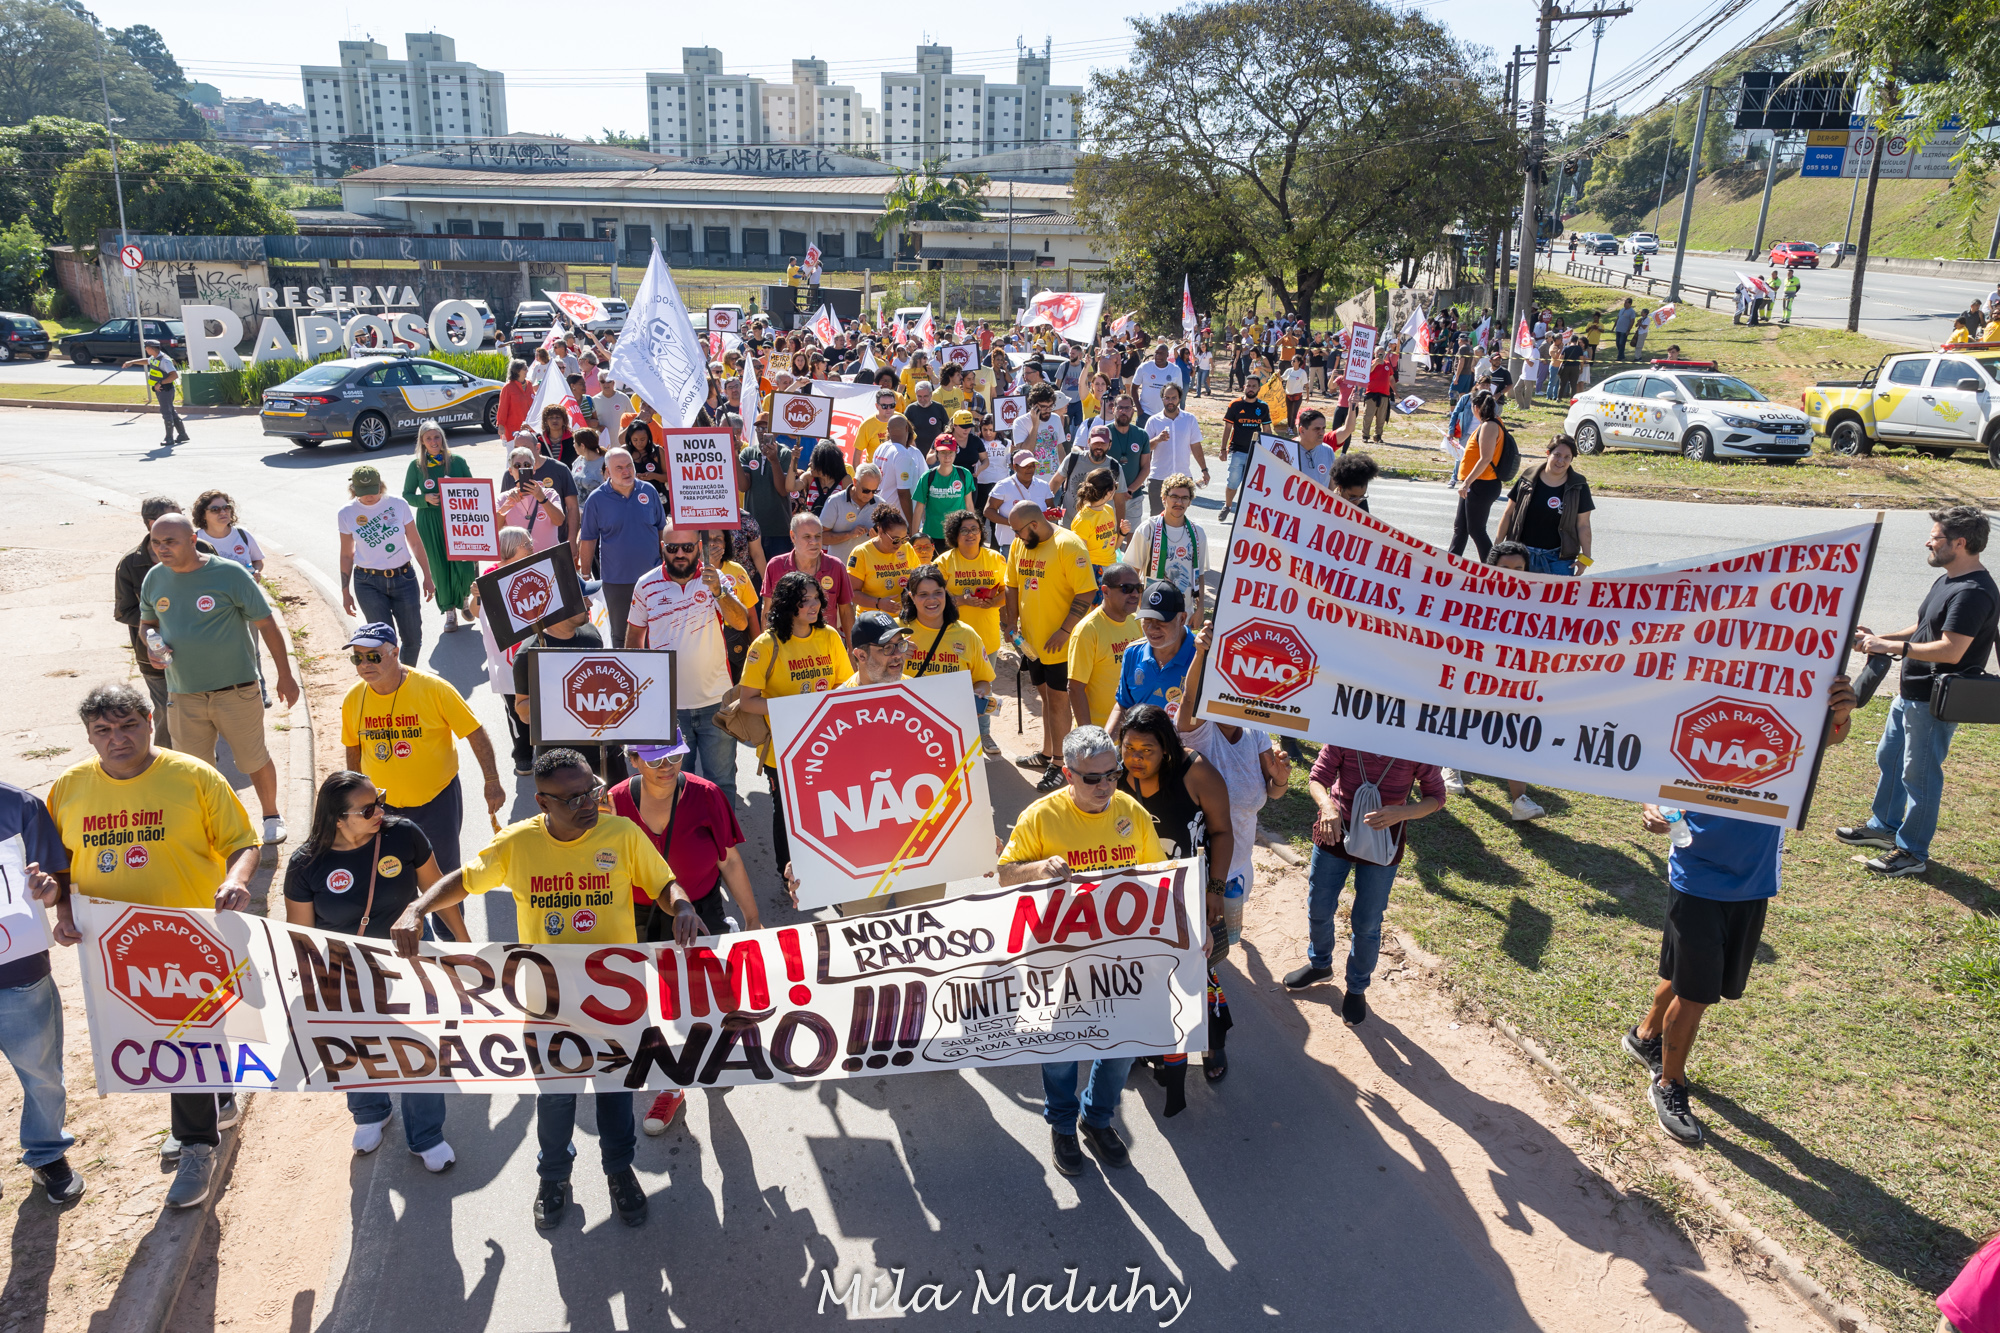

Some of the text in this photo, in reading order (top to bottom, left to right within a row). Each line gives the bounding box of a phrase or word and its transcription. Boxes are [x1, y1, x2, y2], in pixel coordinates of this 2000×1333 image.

[1891, 141, 1903, 150] 80
[257, 286, 420, 308] RESERVA
[181, 299, 484, 371] RAPOSO
[438, 413, 474, 424] MILITAR
[788, 411, 811, 423] NÃO
[1003, 410, 1017, 420] NÃO
[1935, 405, 1960, 418] DER
[1633, 427, 1675, 441] POLÍCIA
[683, 438, 716, 450] NOVA
[676, 451, 727, 464] RAPOSO,
[681, 462, 724, 482] NÃO!
[1247, 463, 1271, 498] A,
[447, 486, 480, 498] METRÔ
[448, 498, 478, 510] SIM!
[450, 512, 490, 522] PEDÁGIO
[360, 522, 382, 539] QUER
[364, 532, 380, 544] SER
[452, 522, 485, 536] NÃO!
[1152, 523, 1163, 571] PALESTINE
[1243, 502, 1844, 617] ESTA AQUI HÁ 10 ANOS DE EXISTÊNCIA COM
[955, 569, 977, 579] Metrô
[955, 577, 981, 587] Pedágio
[516, 591, 546, 615] NÃO
[1232, 539, 1282, 572] 998
[1289, 556, 1405, 615] FAMÍLIAS,
[1415, 595, 1435, 618] E
[1440, 598, 1621, 647] PRECISAMOS
[1629, 621, 1685, 646] SER
[1693, 618, 1838, 660] OUVIDOS
[1231, 577, 1816, 699] PELO GOVERNADOR TARCISIO DE FREITAS
[787, 654, 833, 671] Metrô sim!
[938, 652, 959, 664] sim!
[790, 668, 822, 682] Pedágio
[942, 663, 960, 673] não!
[1231, 655, 1301, 684] NÃO
[1438, 664, 1544, 703] E CDHU.
[576, 687, 629, 712] NÃO
[1244, 709, 1272, 719] anos
[1290, 705, 1301, 714] 10
[365, 713, 419, 729] Metrô sim!
[1332, 683, 1406, 728] NOVA
[1416, 703, 1543, 753] RAPOSO
[1573, 721, 1642, 771] NÃO
[401, 726, 422, 738] não!
[1690, 738, 1779, 771] NÃO
[817, 768, 948, 838] NÃO
[1705, 793, 1740, 805] anos
[1763, 791, 1778, 801] 10
[82, 809, 164, 833] Metrô sim!
[82, 827, 165, 848] Pedágio não!
[128, 855, 147, 864] NÃO
[1067, 844, 1136, 866] Metrô sim!
[332, 879, 349, 888] NÃO
[530, 871, 610, 893] Metrô sim!
[530, 890, 613, 909] Pedágio não!
[575, 919, 593, 928] NÃO
[1006, 877, 1171, 953] NÃO!
[842, 910, 945, 947] NOVA
[853, 927, 995, 972] RAPOSO
[126, 962, 222, 999] NÃO
[287, 927, 813, 1026] METRÔ SIM!
[943, 969, 1055, 1023] JUNTE-SE
[1064, 966, 1082, 1004] A
[965, 1014, 1030, 1035] NESTA
[1038, 1003, 1092, 1021] LUTA
[941, 1036, 983, 1048] SAIBA
[987, 1028, 1017, 1041] MAIS
[975, 1040, 1011, 1054] NOVA
[312, 1020, 595, 1084] PEDÁGIO
[111, 1039, 279, 1086] COTIA
